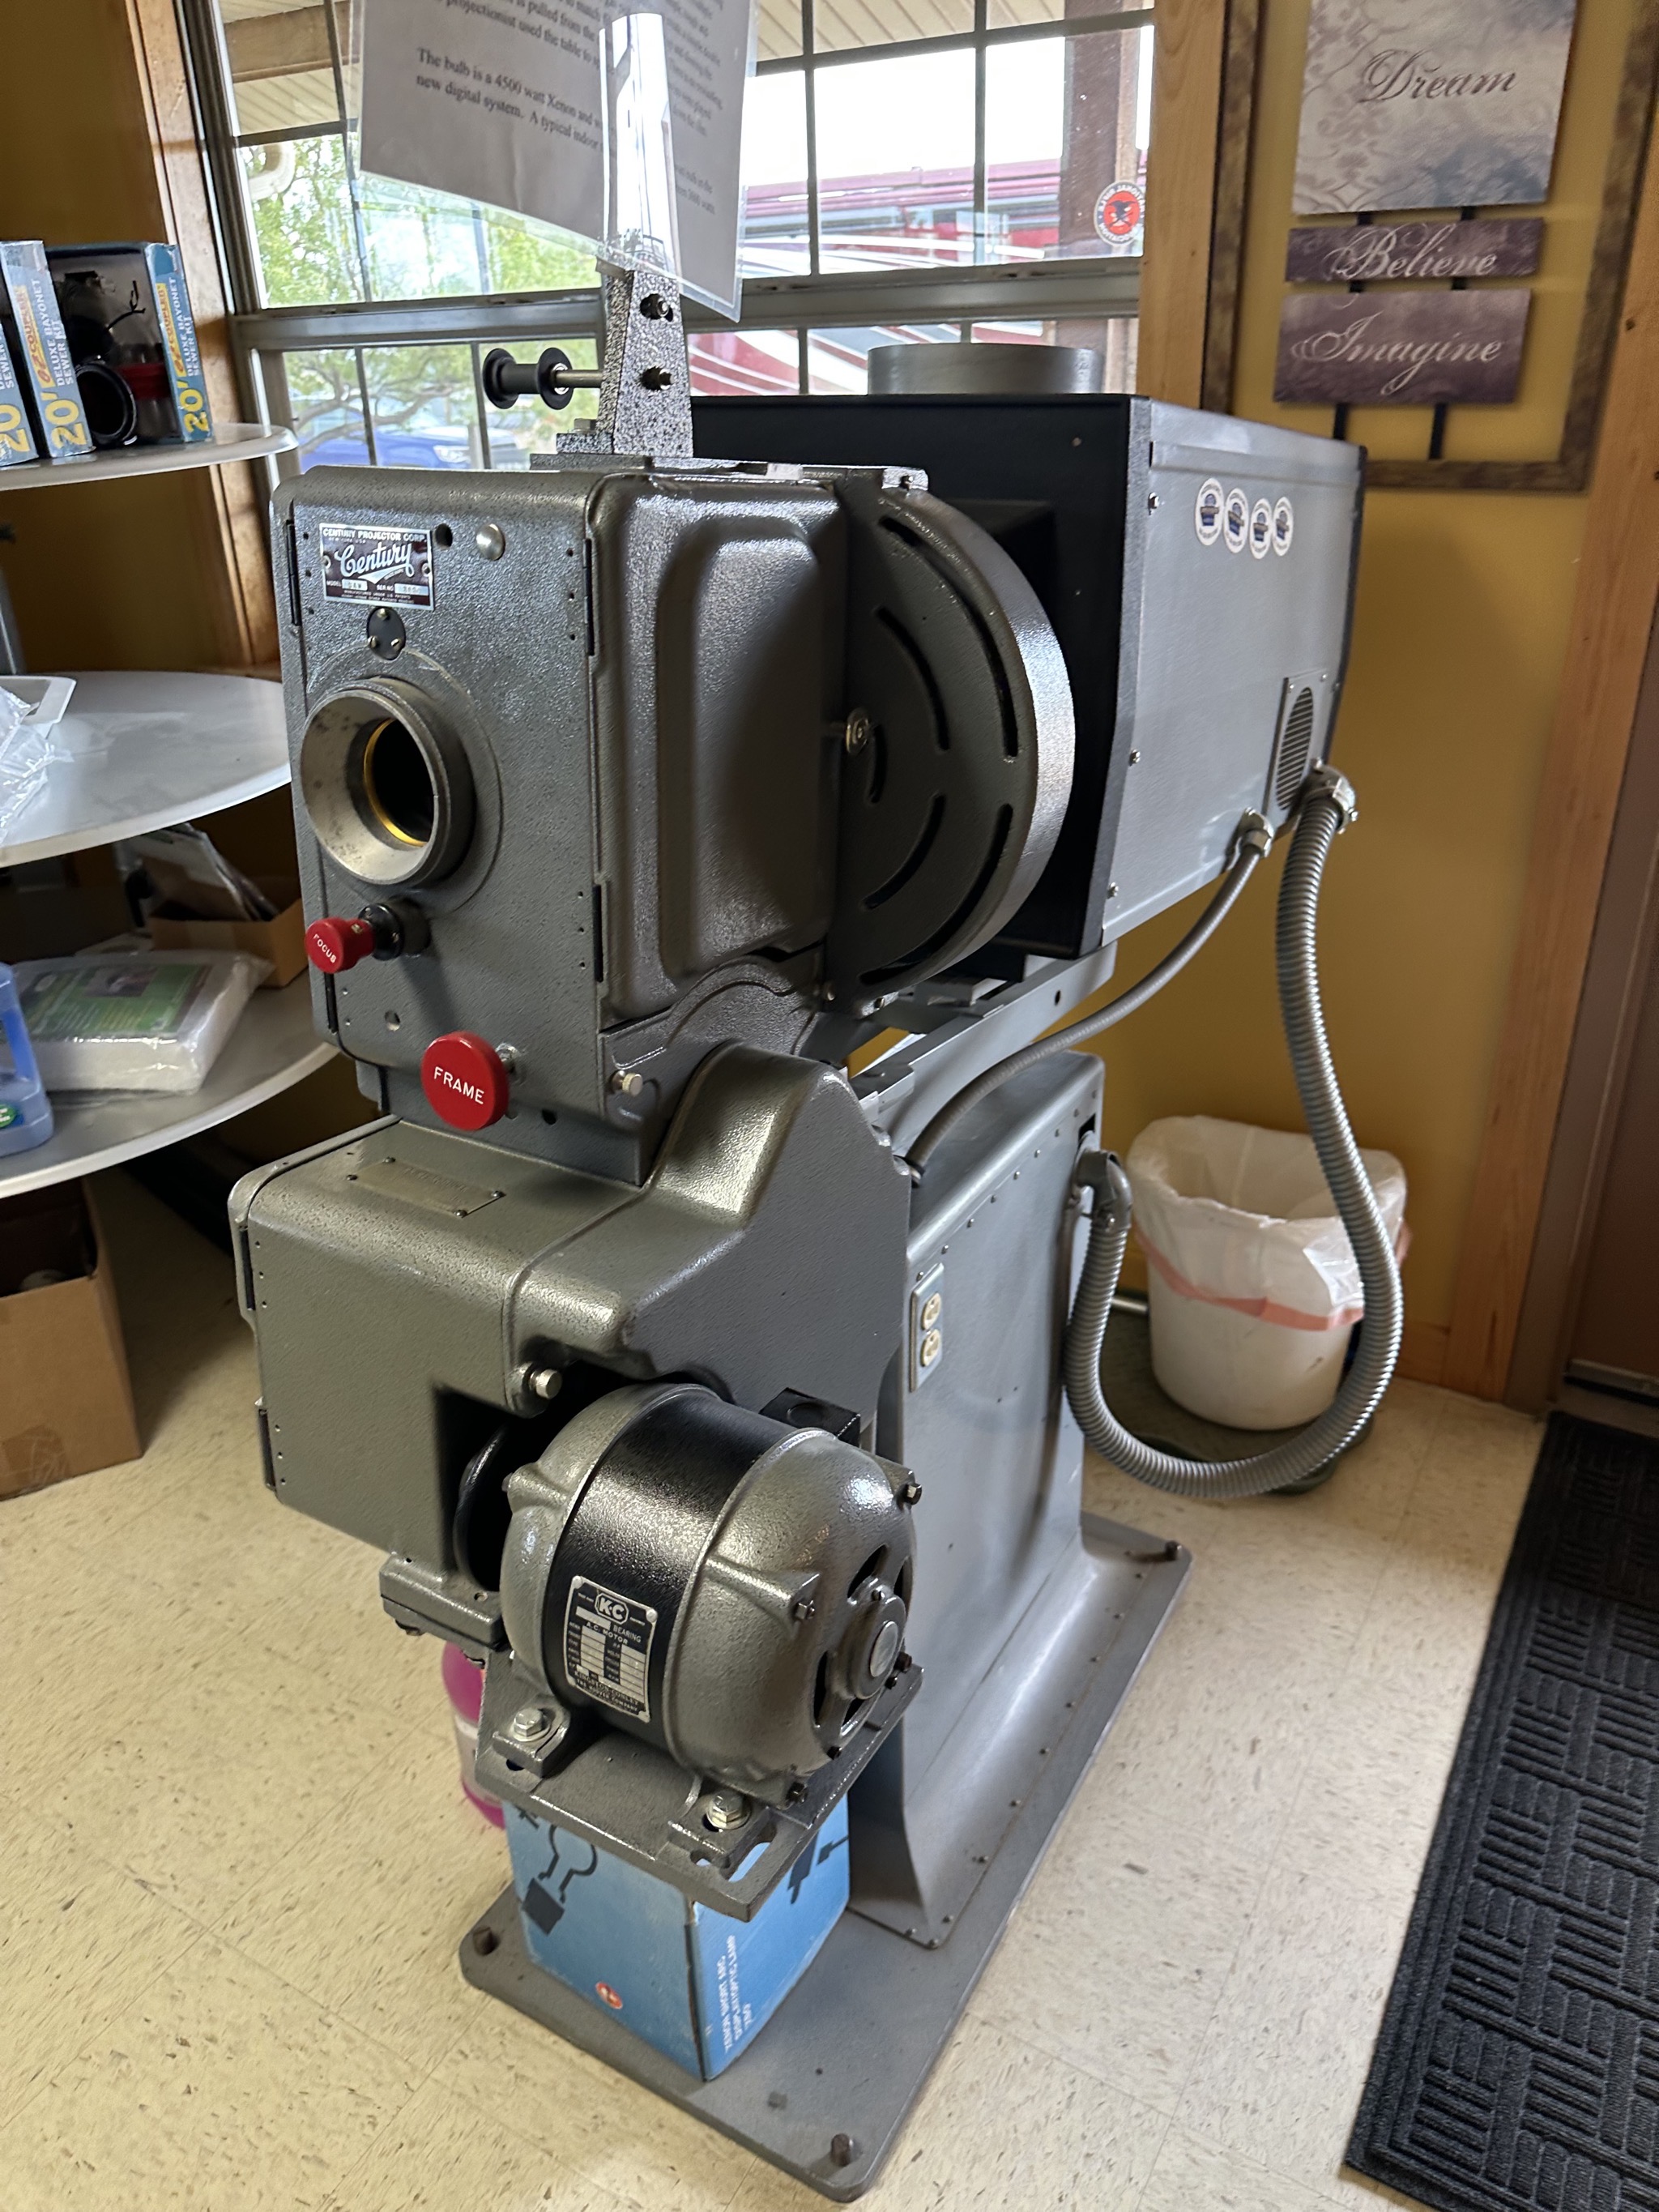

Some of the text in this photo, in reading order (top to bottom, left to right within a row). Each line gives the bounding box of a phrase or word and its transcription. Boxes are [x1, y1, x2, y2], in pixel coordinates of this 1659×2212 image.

[417, 47, 441, 67] The
[445, 56, 470, 76] bulb
[1358, 49, 1518, 104] Dream
[417, 75, 441, 90] new
[445, 82, 481, 105] digital
[1323, 223, 1498, 281] Believe
[168, 277, 186, 331] BAYONET
[31, 278, 66, 386] DELUXE BAYONET
[51, 319, 75, 385] SEWER KIT
[180, 330, 194, 377] DELUXE
[1291, 310, 1504, 396] Imagine
[322, 528, 428, 543] CENTURY PROJECTOR CORP.
[334, 541, 415, 578] Century
[312, 933, 337, 963] FOCUS
[433, 1065, 485, 1104] FRAME
[602, 1629, 629, 1645] MOTOR
[612, 1625, 642, 1643] BEARING
